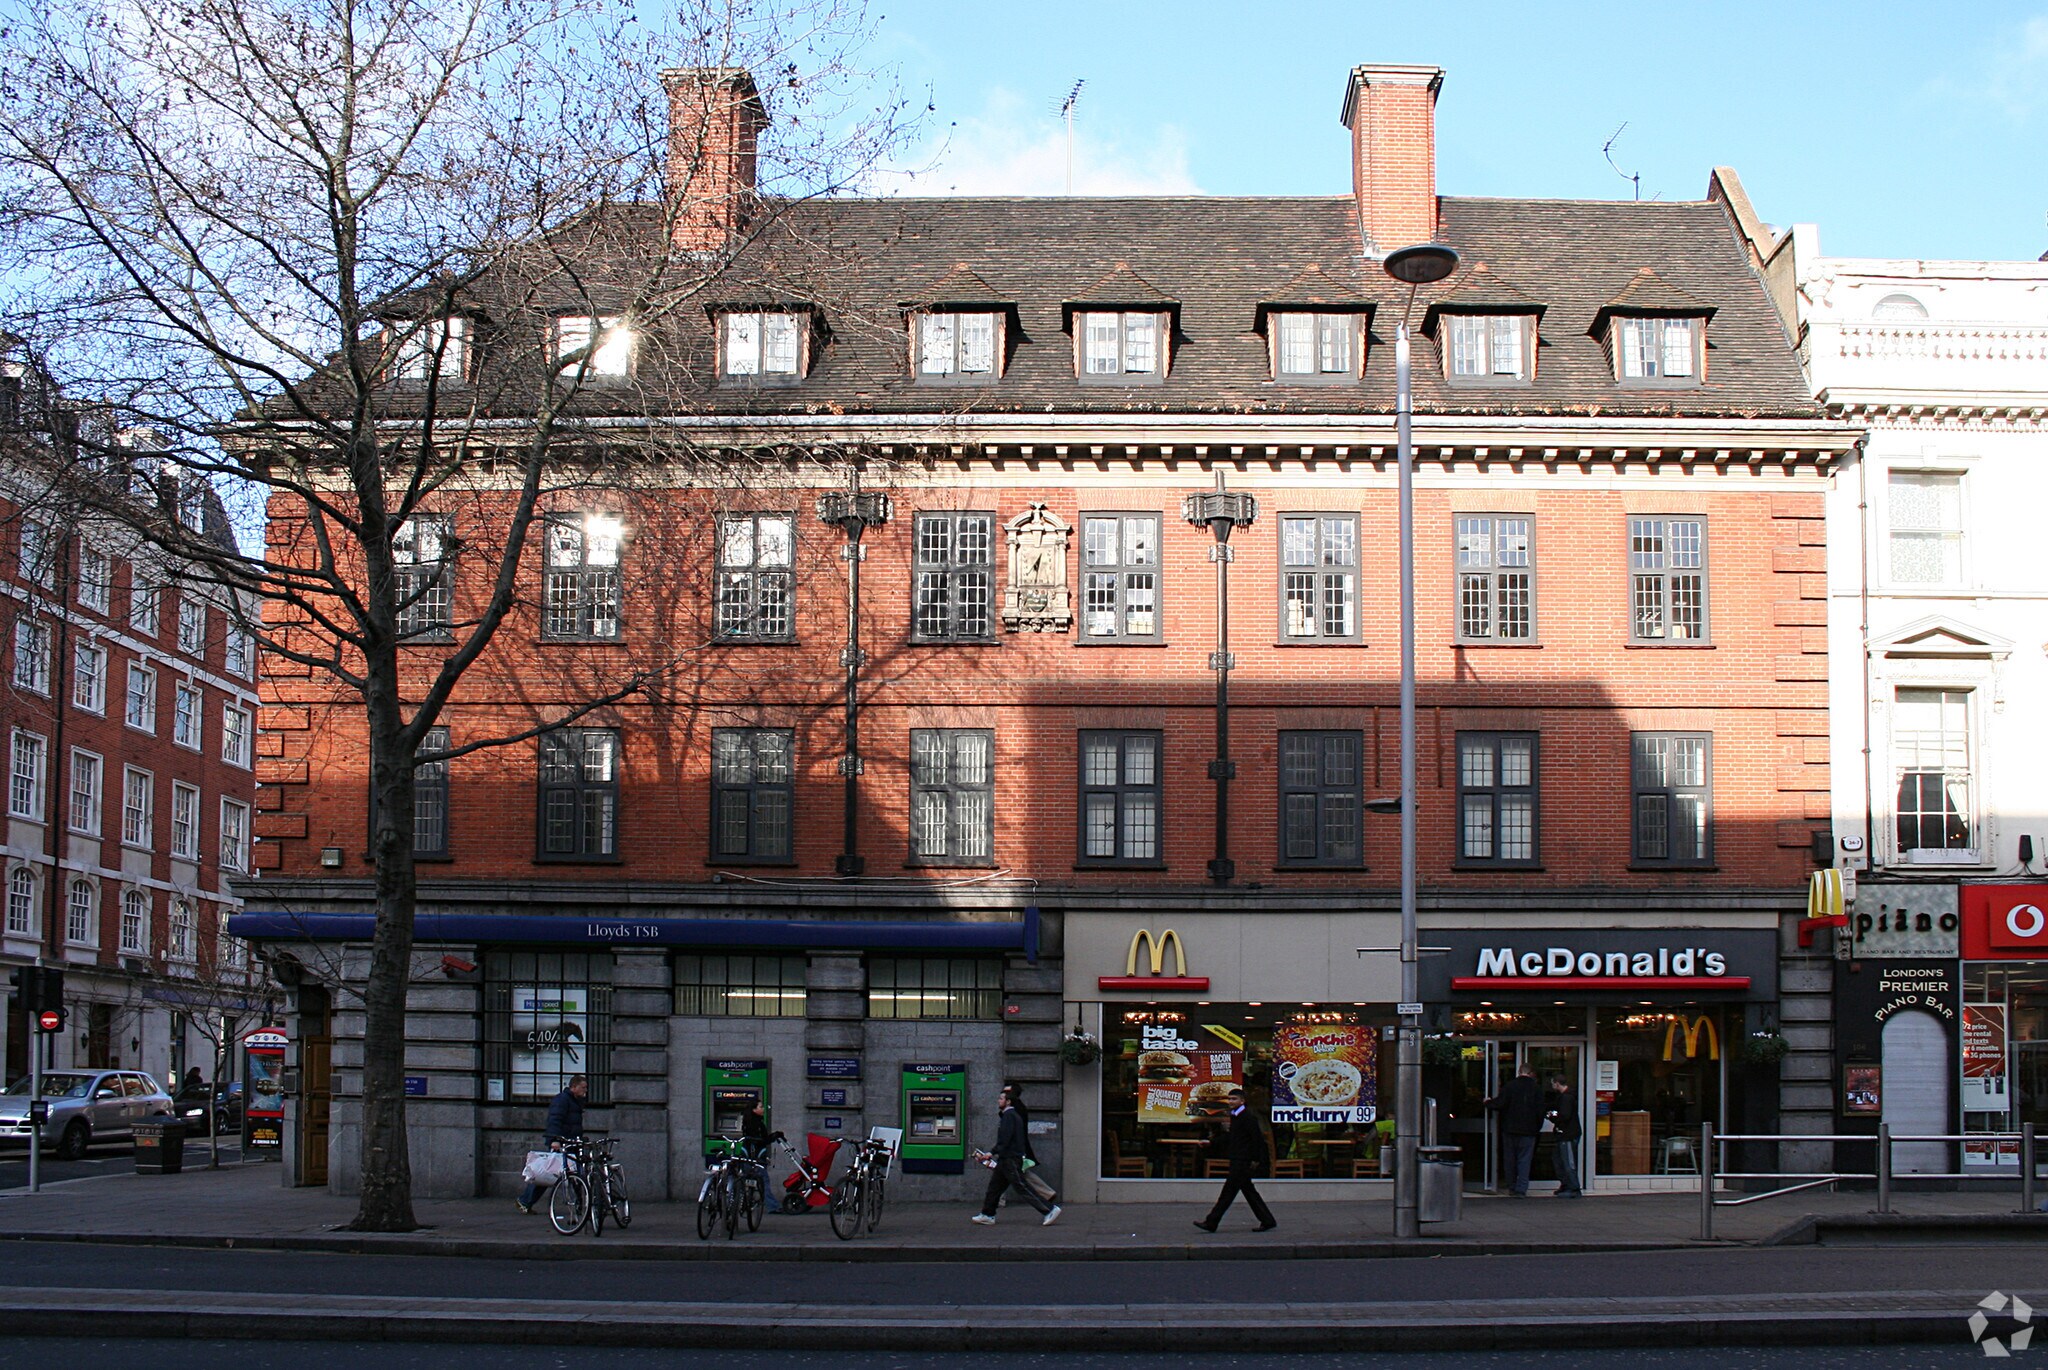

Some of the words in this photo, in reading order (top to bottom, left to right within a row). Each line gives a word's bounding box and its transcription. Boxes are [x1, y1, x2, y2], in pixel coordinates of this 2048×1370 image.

[587, 924, 630, 940] Lloyds
[633, 925, 659, 938] TSB
[1475, 947, 1726, 977] McDonald's
[1883, 968, 1944, 978] LONDON'S
[1879, 980, 1949, 992] PREMIER
[1874, 995, 1917, 1022] PIANO
[1925, 995, 1953, 1019] BAR
[1143, 1025, 1178, 1040] big
[1971, 1023, 1987, 1031] price
[527, 1030, 560, 1052] 64%
[1141, 1038, 1199, 1050] taste
[1293, 1033, 1355, 1048] crunchie
[1210, 1054, 1232, 1063] BACON
[916, 1065, 951, 1073] cashpoint
[1210, 1062, 1232, 1071] QUARTER
[1211, 1069, 1233, 1077] POUNDER
[1145, 1087, 1156, 1111] DOUBLE
[1155, 1089, 1183, 1101] QUARTER
[1154, 1098, 1181, 1109] POUNDER
[1273, 1107, 1350, 1124] mcflurry
